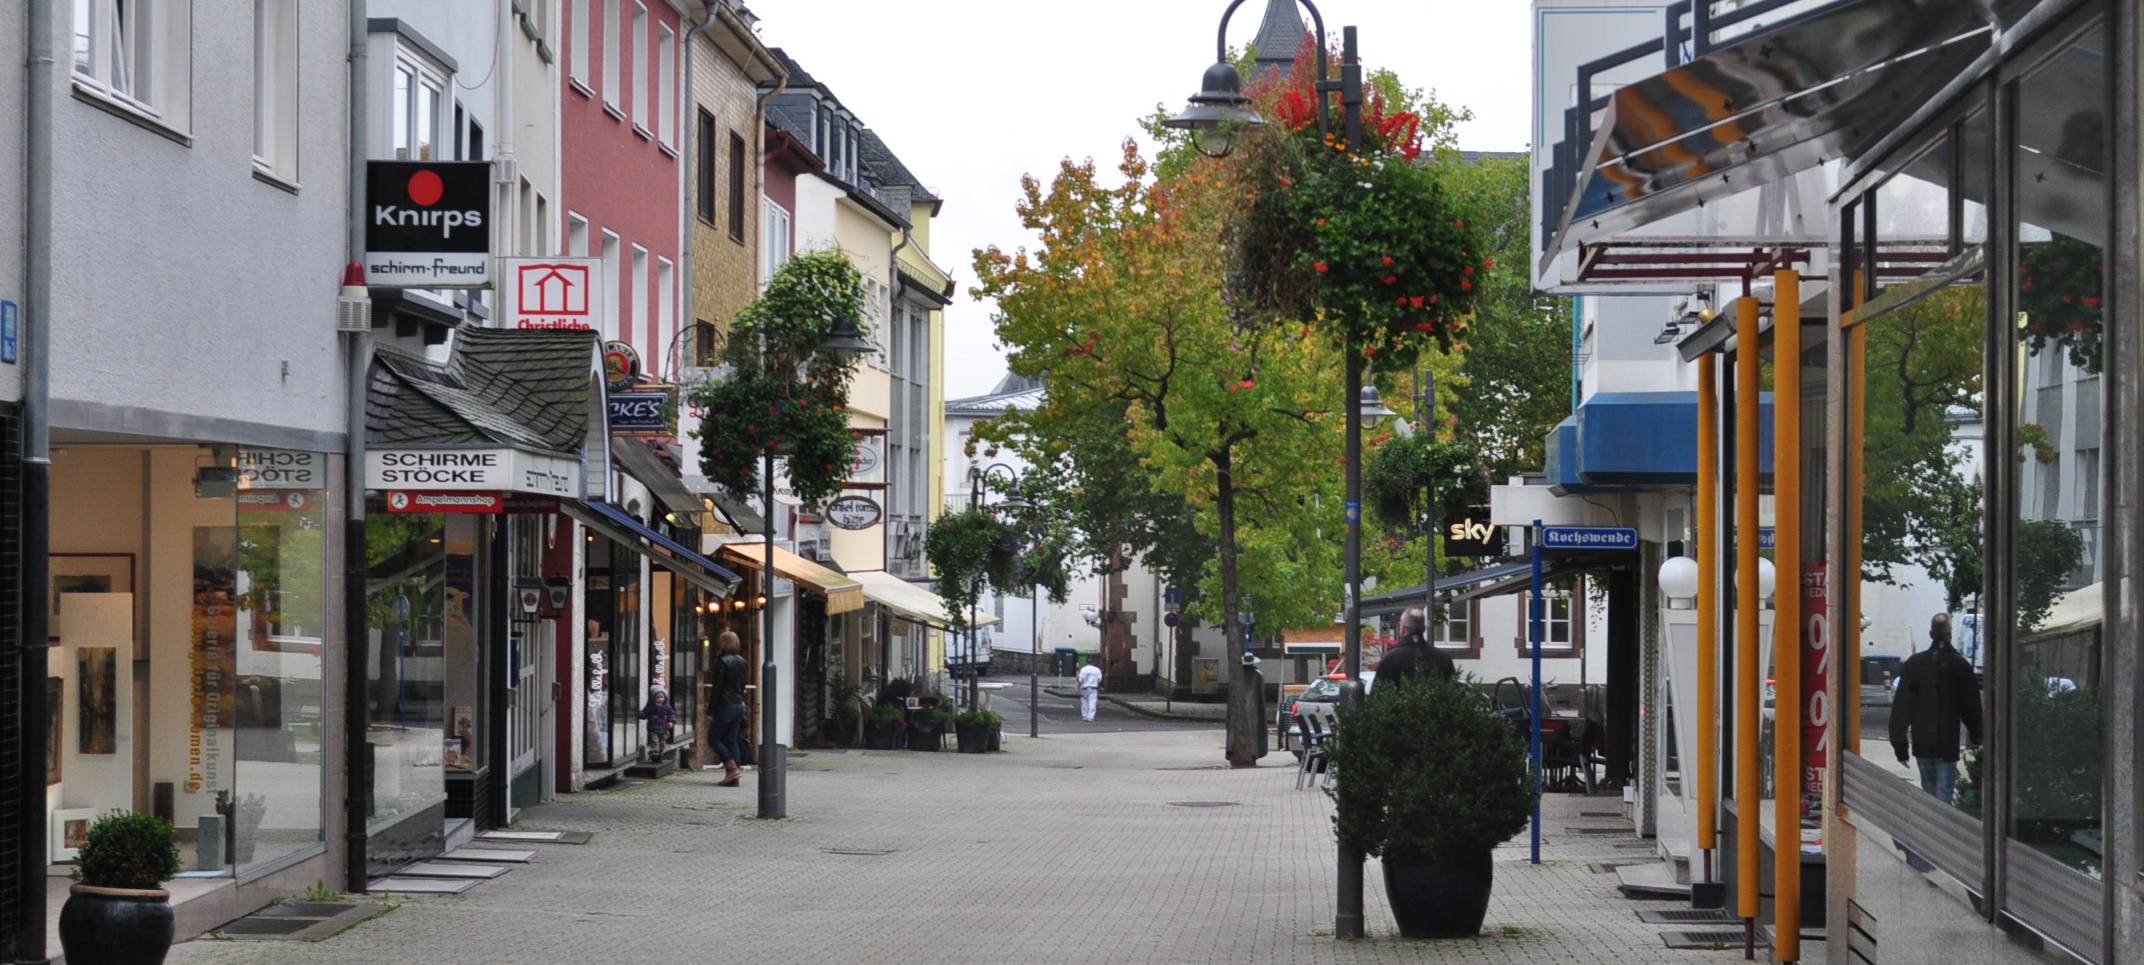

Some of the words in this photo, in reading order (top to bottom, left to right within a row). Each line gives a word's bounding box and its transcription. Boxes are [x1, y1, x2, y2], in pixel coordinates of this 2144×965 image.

[376, 205, 482, 239] Knirps
[370, 258, 485, 277] schirm-freund
[382, 453, 497, 467] SCHIRME
[382, 467, 485, 483] STÖCKE
[416, 494, 496, 507] Ampelmannshop
[1450, 517, 1495, 545] sky
[1548, 530, 1631, 545] Kochswende
[203, 691, 220, 795] Originalkunst
